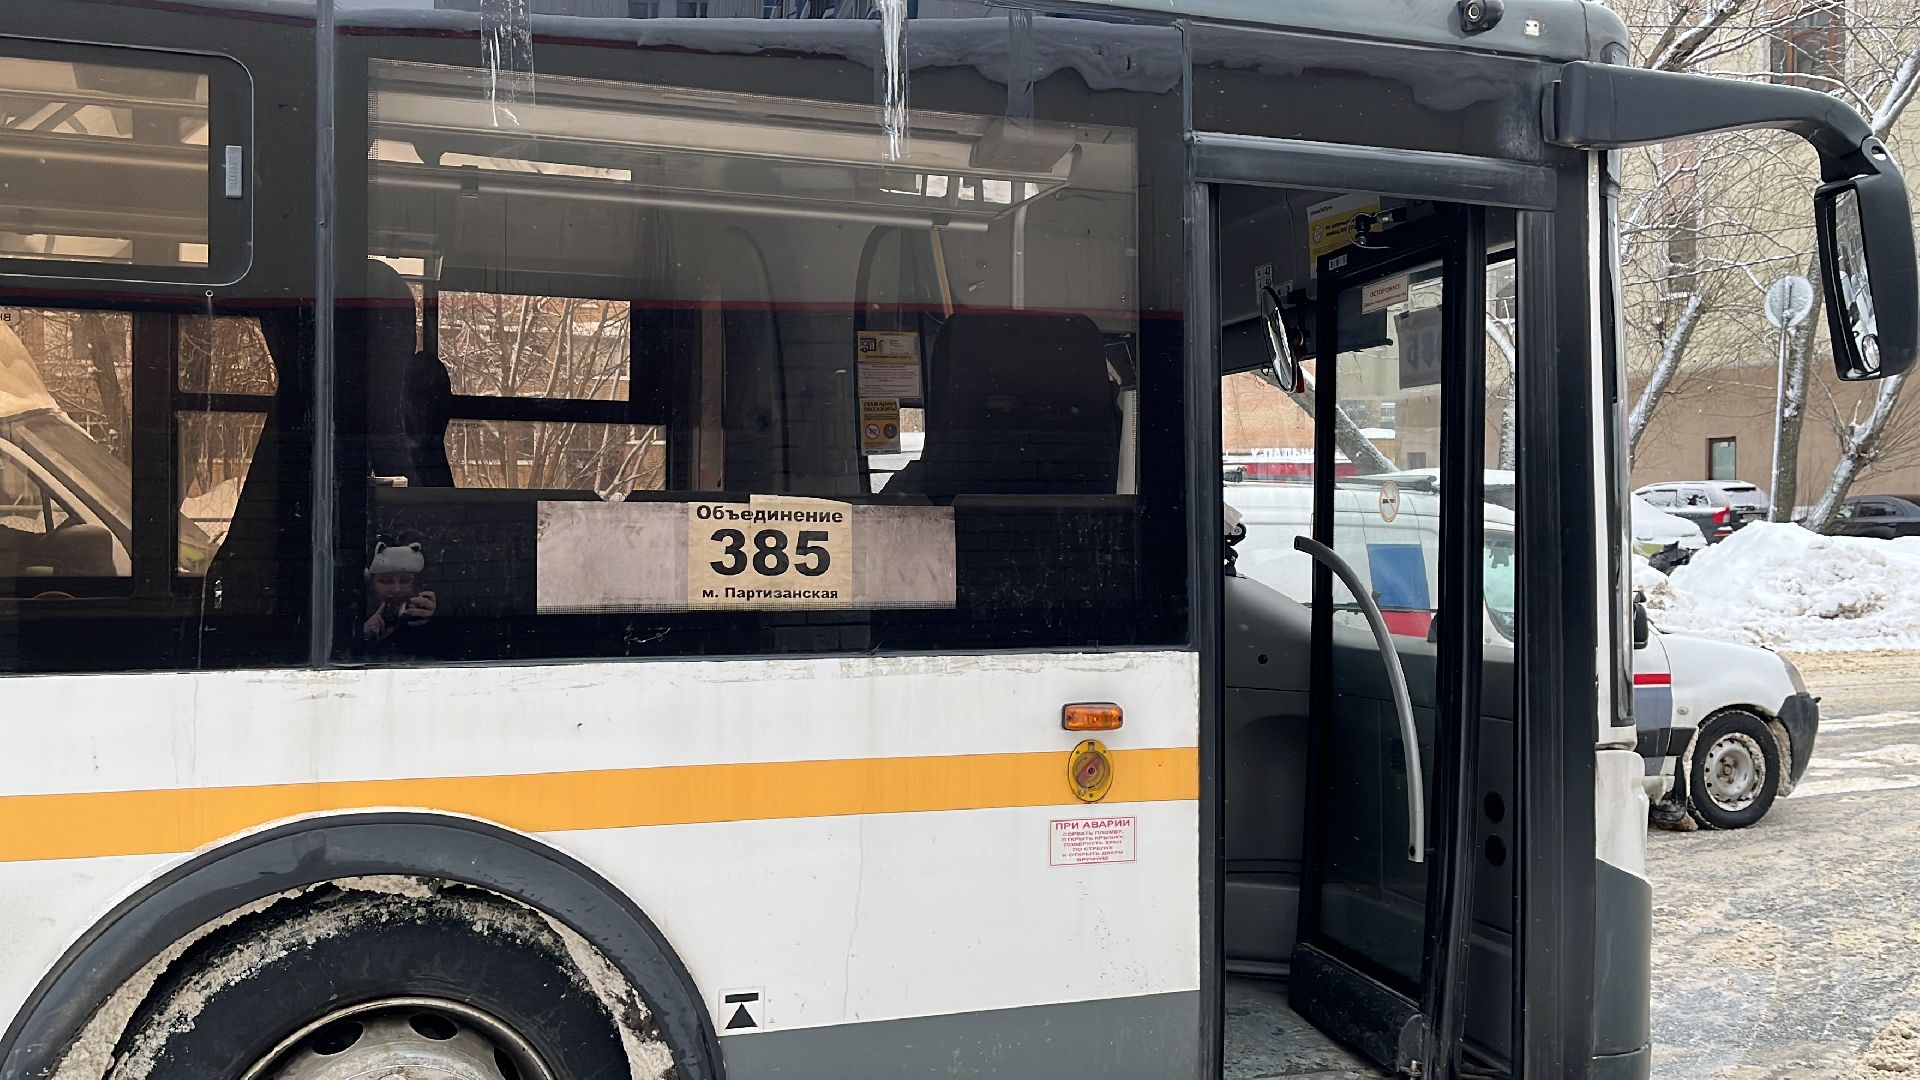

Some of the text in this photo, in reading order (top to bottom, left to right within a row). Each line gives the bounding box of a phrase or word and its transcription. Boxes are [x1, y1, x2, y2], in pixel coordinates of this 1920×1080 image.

[696, 504, 843, 523] Объединение
[710, 528, 831, 576] 385
[702, 587, 838, 601] м. Партизанская
[1055, 819, 1131, 830] ПРИ АВАРИИ
